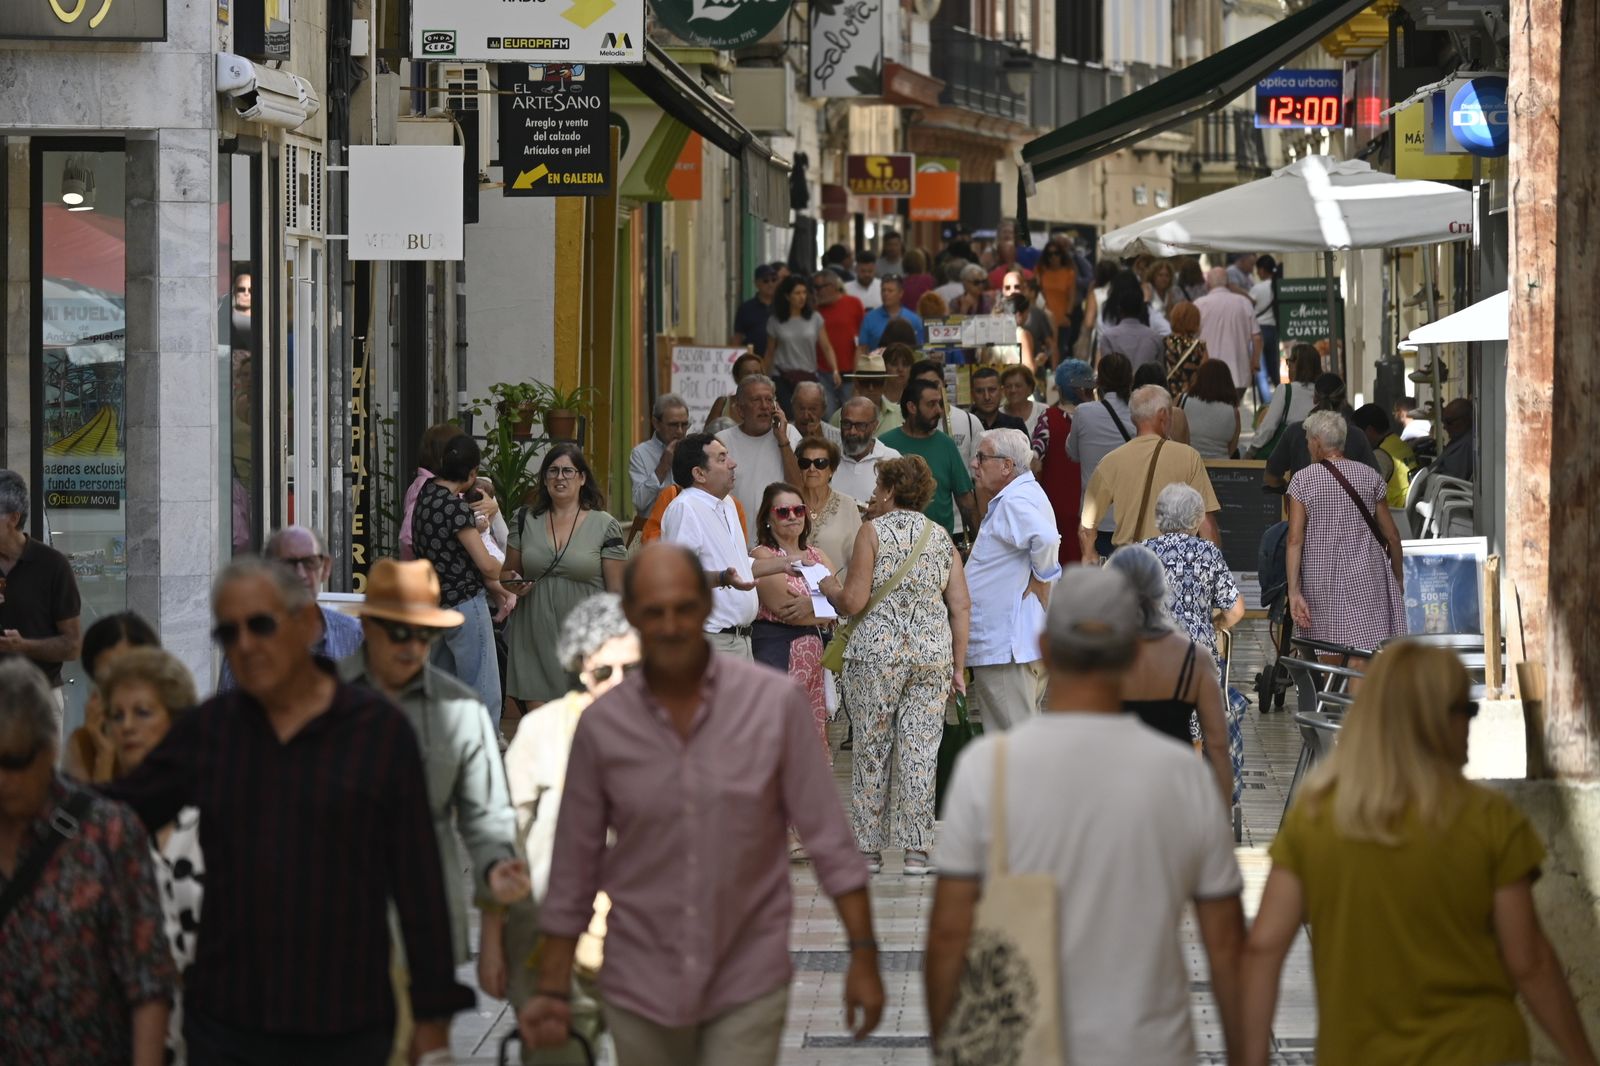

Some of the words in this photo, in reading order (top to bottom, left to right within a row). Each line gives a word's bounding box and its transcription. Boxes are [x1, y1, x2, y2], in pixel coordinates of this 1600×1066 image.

[504, 38, 568, 48] EUROPAFM
[815, 2, 878, 90] salvia
[1298, 77, 1338, 87] urbano
[514, 83, 531, 94] EL
[1270, 97, 1337, 125] 12:00
[525, 117, 556, 129] Arreglo
[558, 120, 563, 129] y
[565, 118, 589, 127] venta
[533, 131, 547, 140] del
[549, 131, 581, 140] calzado
[523, 145, 559, 155] Artículos
[561, 147, 572, 155] en
[575, 144, 591, 157] piel
[548, 173, 560, 184] EN
[563, 173, 604, 184] GALERIA
[850, 179, 909, 193] TABACOS
[63, 306, 124, 321] HUELV
[48, 477, 76, 489] funda
[352, 367, 368, 594] ZAPATERO
[90, 496, 116, 505] MOVIL
